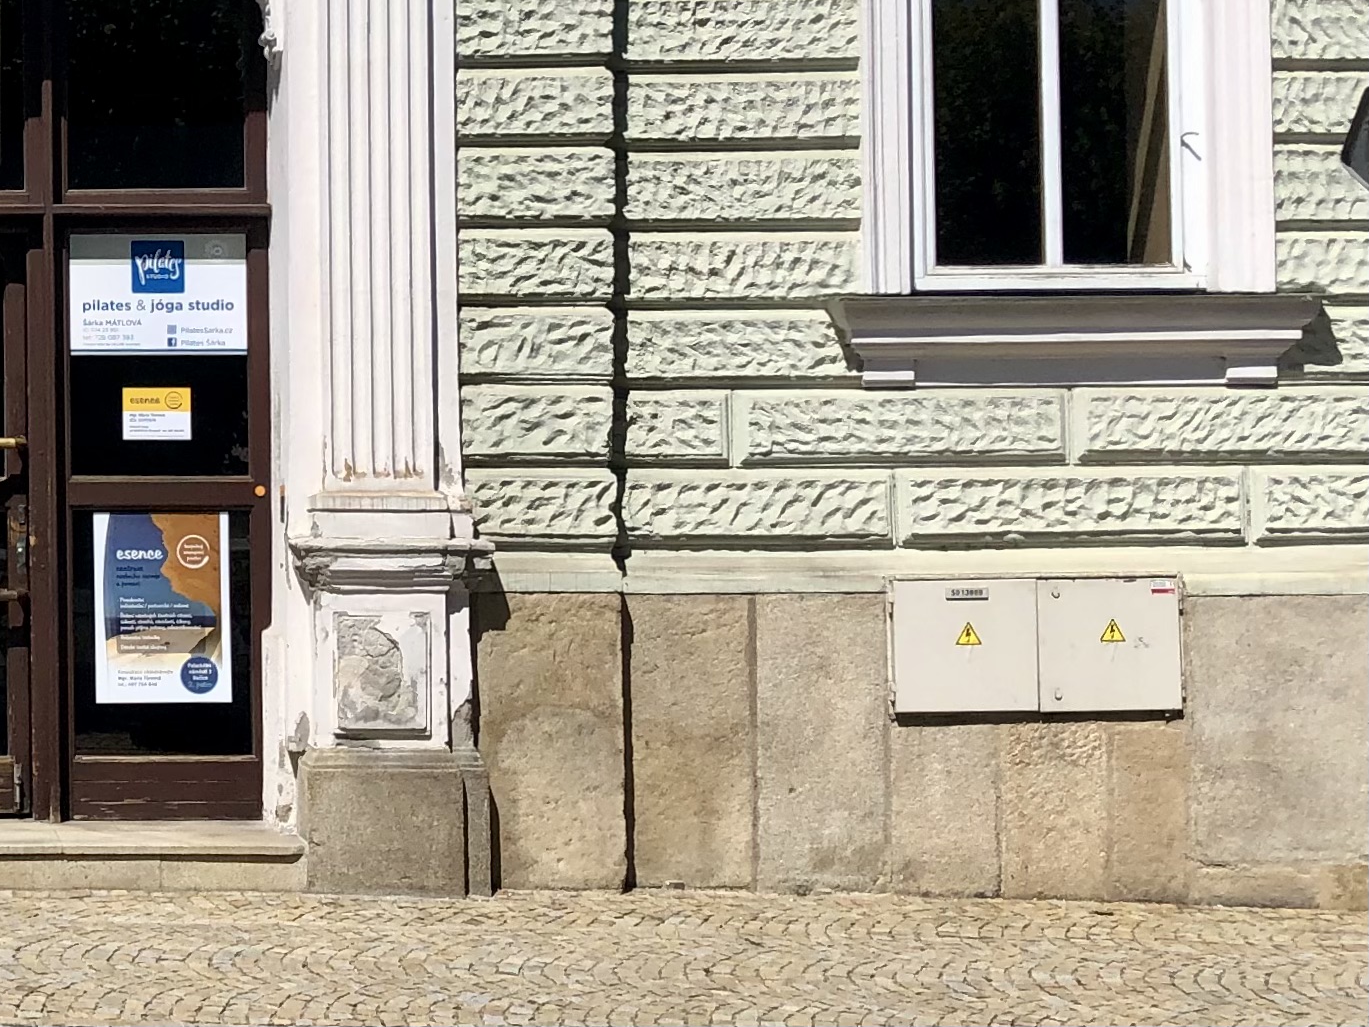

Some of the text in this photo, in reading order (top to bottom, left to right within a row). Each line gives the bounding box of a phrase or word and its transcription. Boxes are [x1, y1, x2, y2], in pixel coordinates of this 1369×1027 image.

[82, 298, 235, 314] pilates & jóga studio
[116, 549, 163, 560] esence
